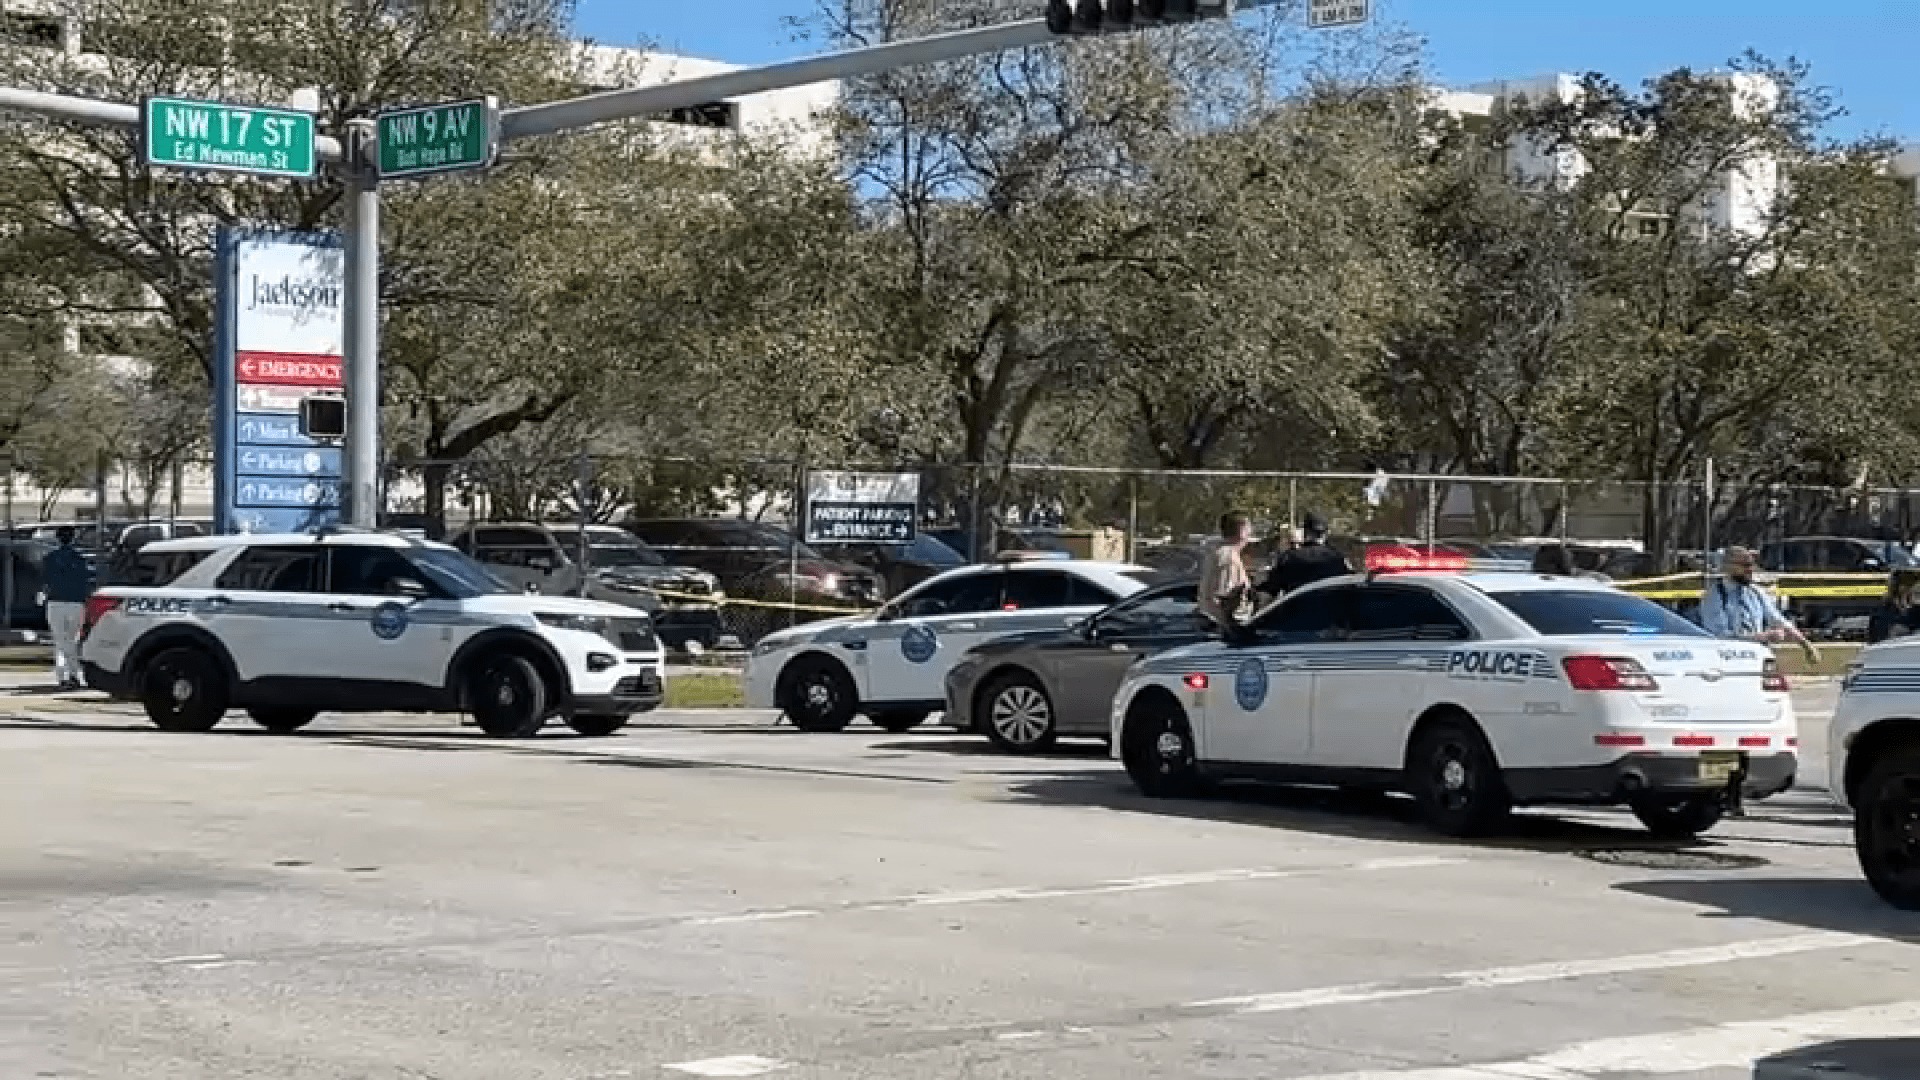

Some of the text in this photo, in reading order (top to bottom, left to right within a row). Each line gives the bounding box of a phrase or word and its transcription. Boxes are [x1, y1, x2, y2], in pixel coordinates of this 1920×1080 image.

[164, 106, 297, 148] NW 17 ST
[388, 107, 470, 147] NW 9 AV
[174, 141, 290, 170] Ed Newman St
[247, 273, 339, 311] Jackson
[258, 360, 342, 379] EMERGENCY
[260, 421, 289, 439] Main
[258, 452, 301, 472] Parking
[258, 483, 302, 503] Parking
[815, 507, 910, 522] PATIENT PARKING
[834, 523, 894, 537] ENTRANCE
[127, 597, 192, 614] POLICE
[1447, 650, 1532, 676] POLICE
